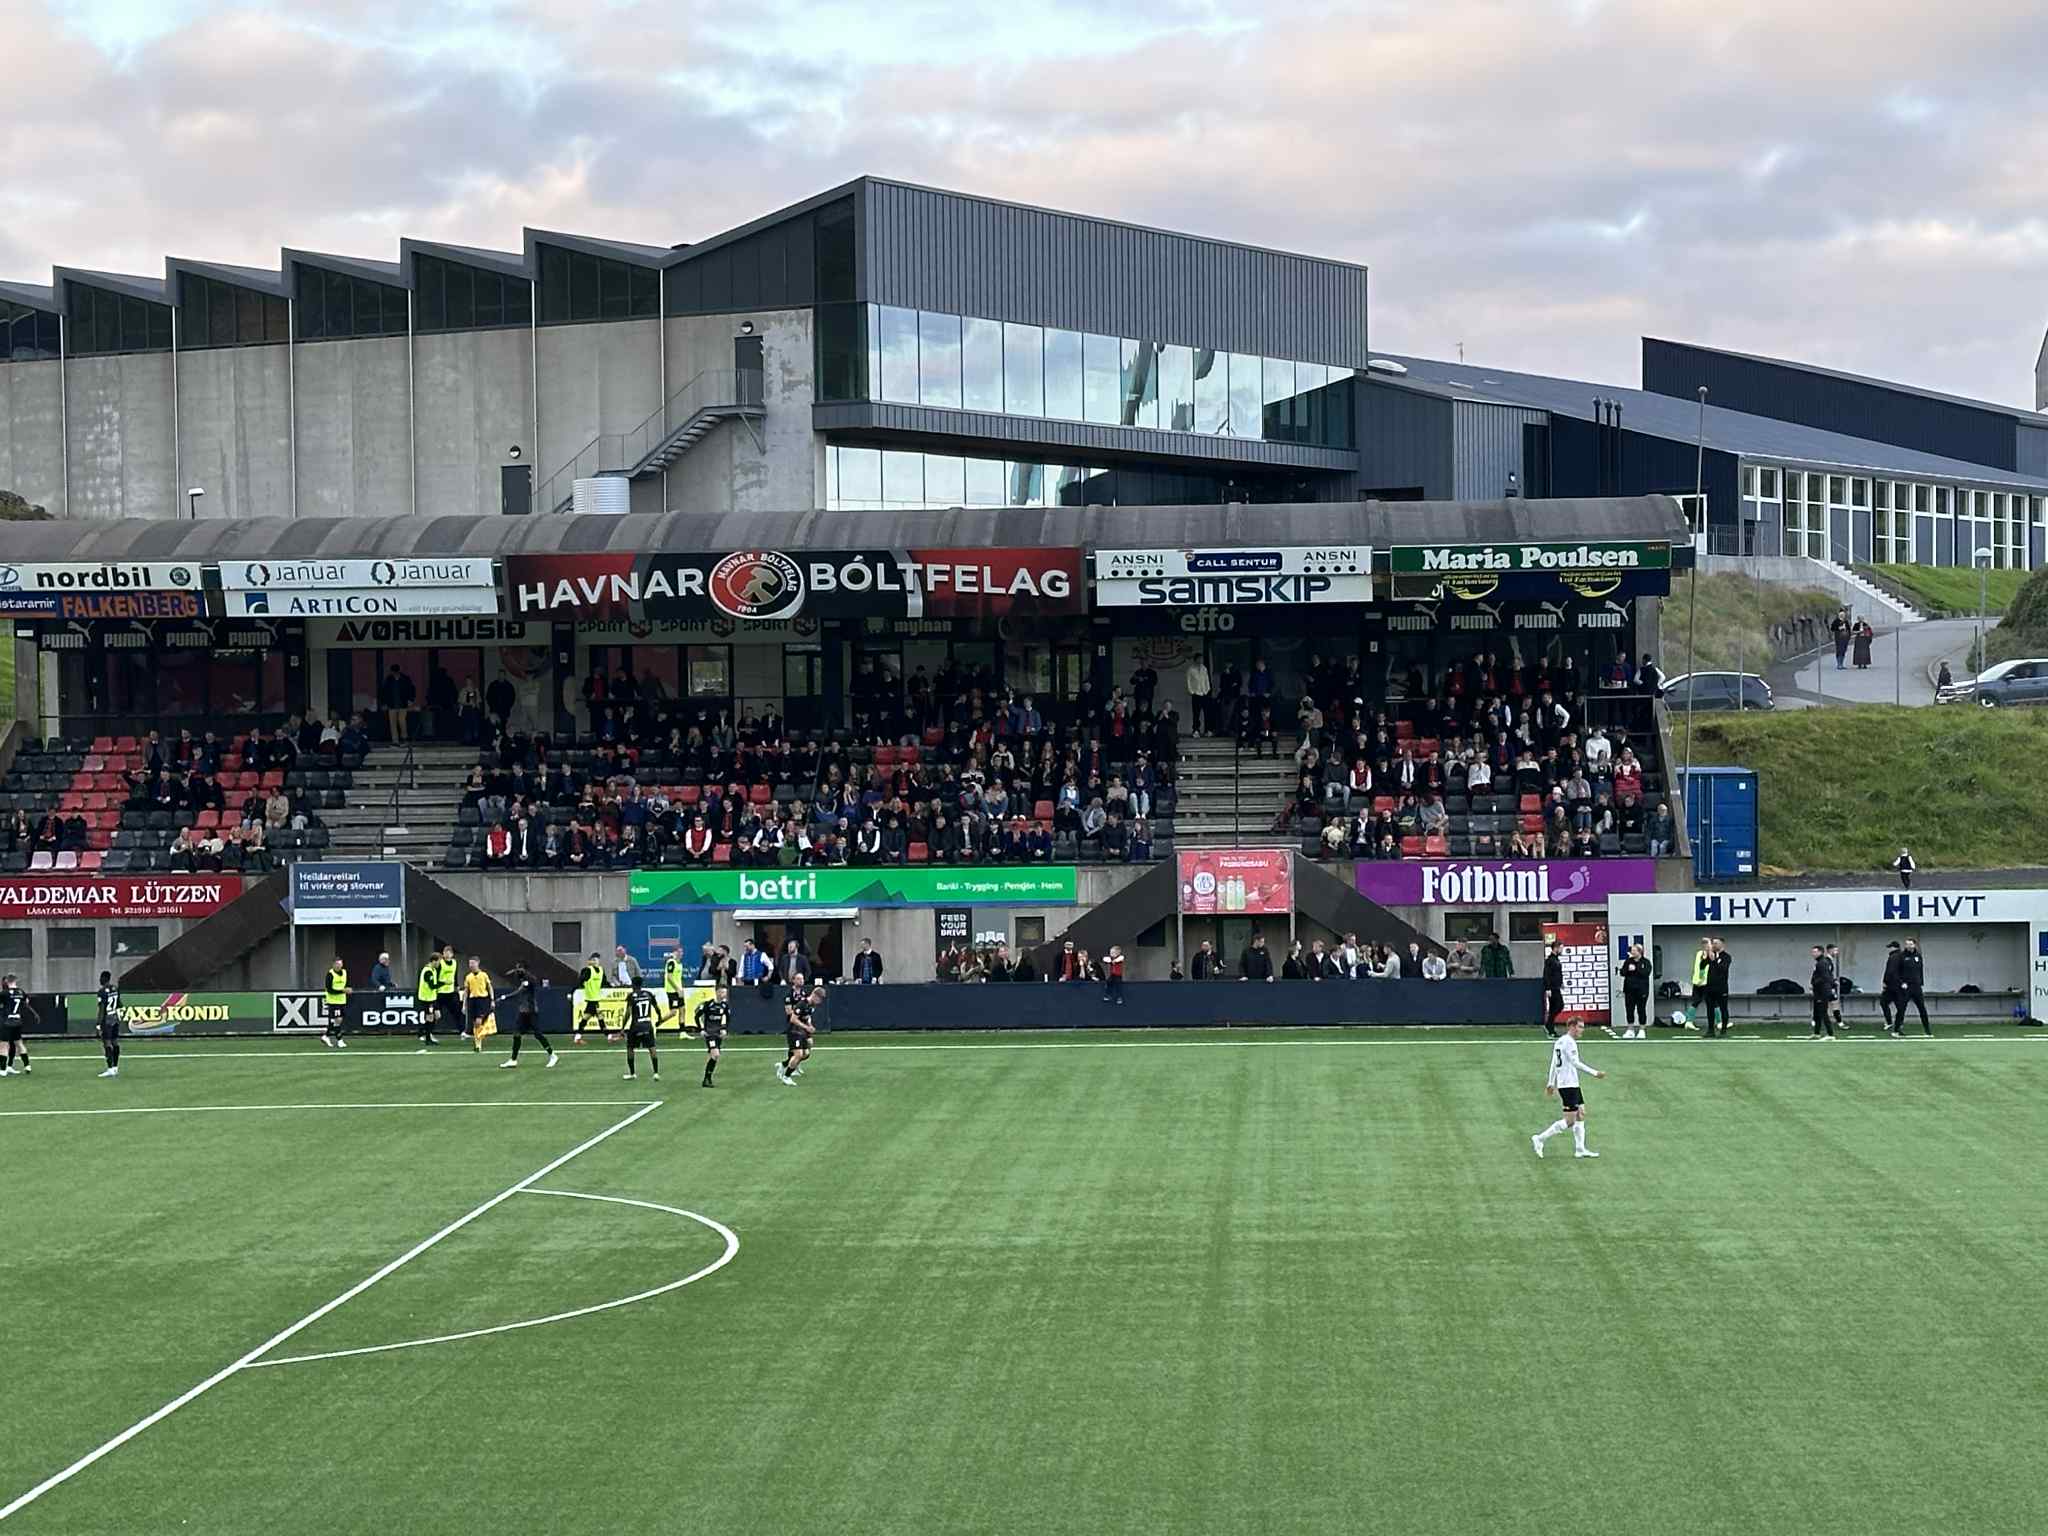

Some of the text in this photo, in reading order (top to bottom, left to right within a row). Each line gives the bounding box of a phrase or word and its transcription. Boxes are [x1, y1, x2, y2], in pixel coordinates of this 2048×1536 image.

[1111, 555, 1164, 564] ANSNI
[1196, 559, 1227, 567] CALL
[1303, 551, 1357, 561] ANSNI
[1422, 546, 1639, 570] Maria Poulsen
[37, 567, 152, 587] nordbil
[518, 555, 1070, 611] HAVNAR BÓLTFELAG
[63, 592, 198, 617] FALKENBERG
[577, 619, 624, 632] SPORT
[660, 619, 706, 632] SPORT
[743, 620, 788, 631] SPORT
[1180, 607, 1235, 632] effo
[1387, 615, 1431, 630] PUMA
[1451, 615, 1494, 629] PUMA
[1514, 614, 1557, 629] PUMA
[1578, 613, 1621, 628] PUMA
[350, 616, 526, 641] VØRUHÚSIÐ
[41, 634, 84, 648] PUMA
[104, 633, 146, 647] PUMA
[166, 632, 210, 647] PUMA
[228, 631, 271, 646] PUMA
[131, 881, 221, 903] LÜTZEN
[336, 883, 348, 892] og
[739, 872, 816, 900] betri
[964, 882, 999, 892] Trygging
[1729, 898, 1796, 918] HVT
[1918, 896, 1985, 916] HVT
[13, 998, 21, 1014] 7
[106, 995, 118, 1012] 27
[636, 1000, 650, 1017] 17
[116, 1006, 229, 1021] FAXE KONDI
[278, 998, 328, 1026] XL
